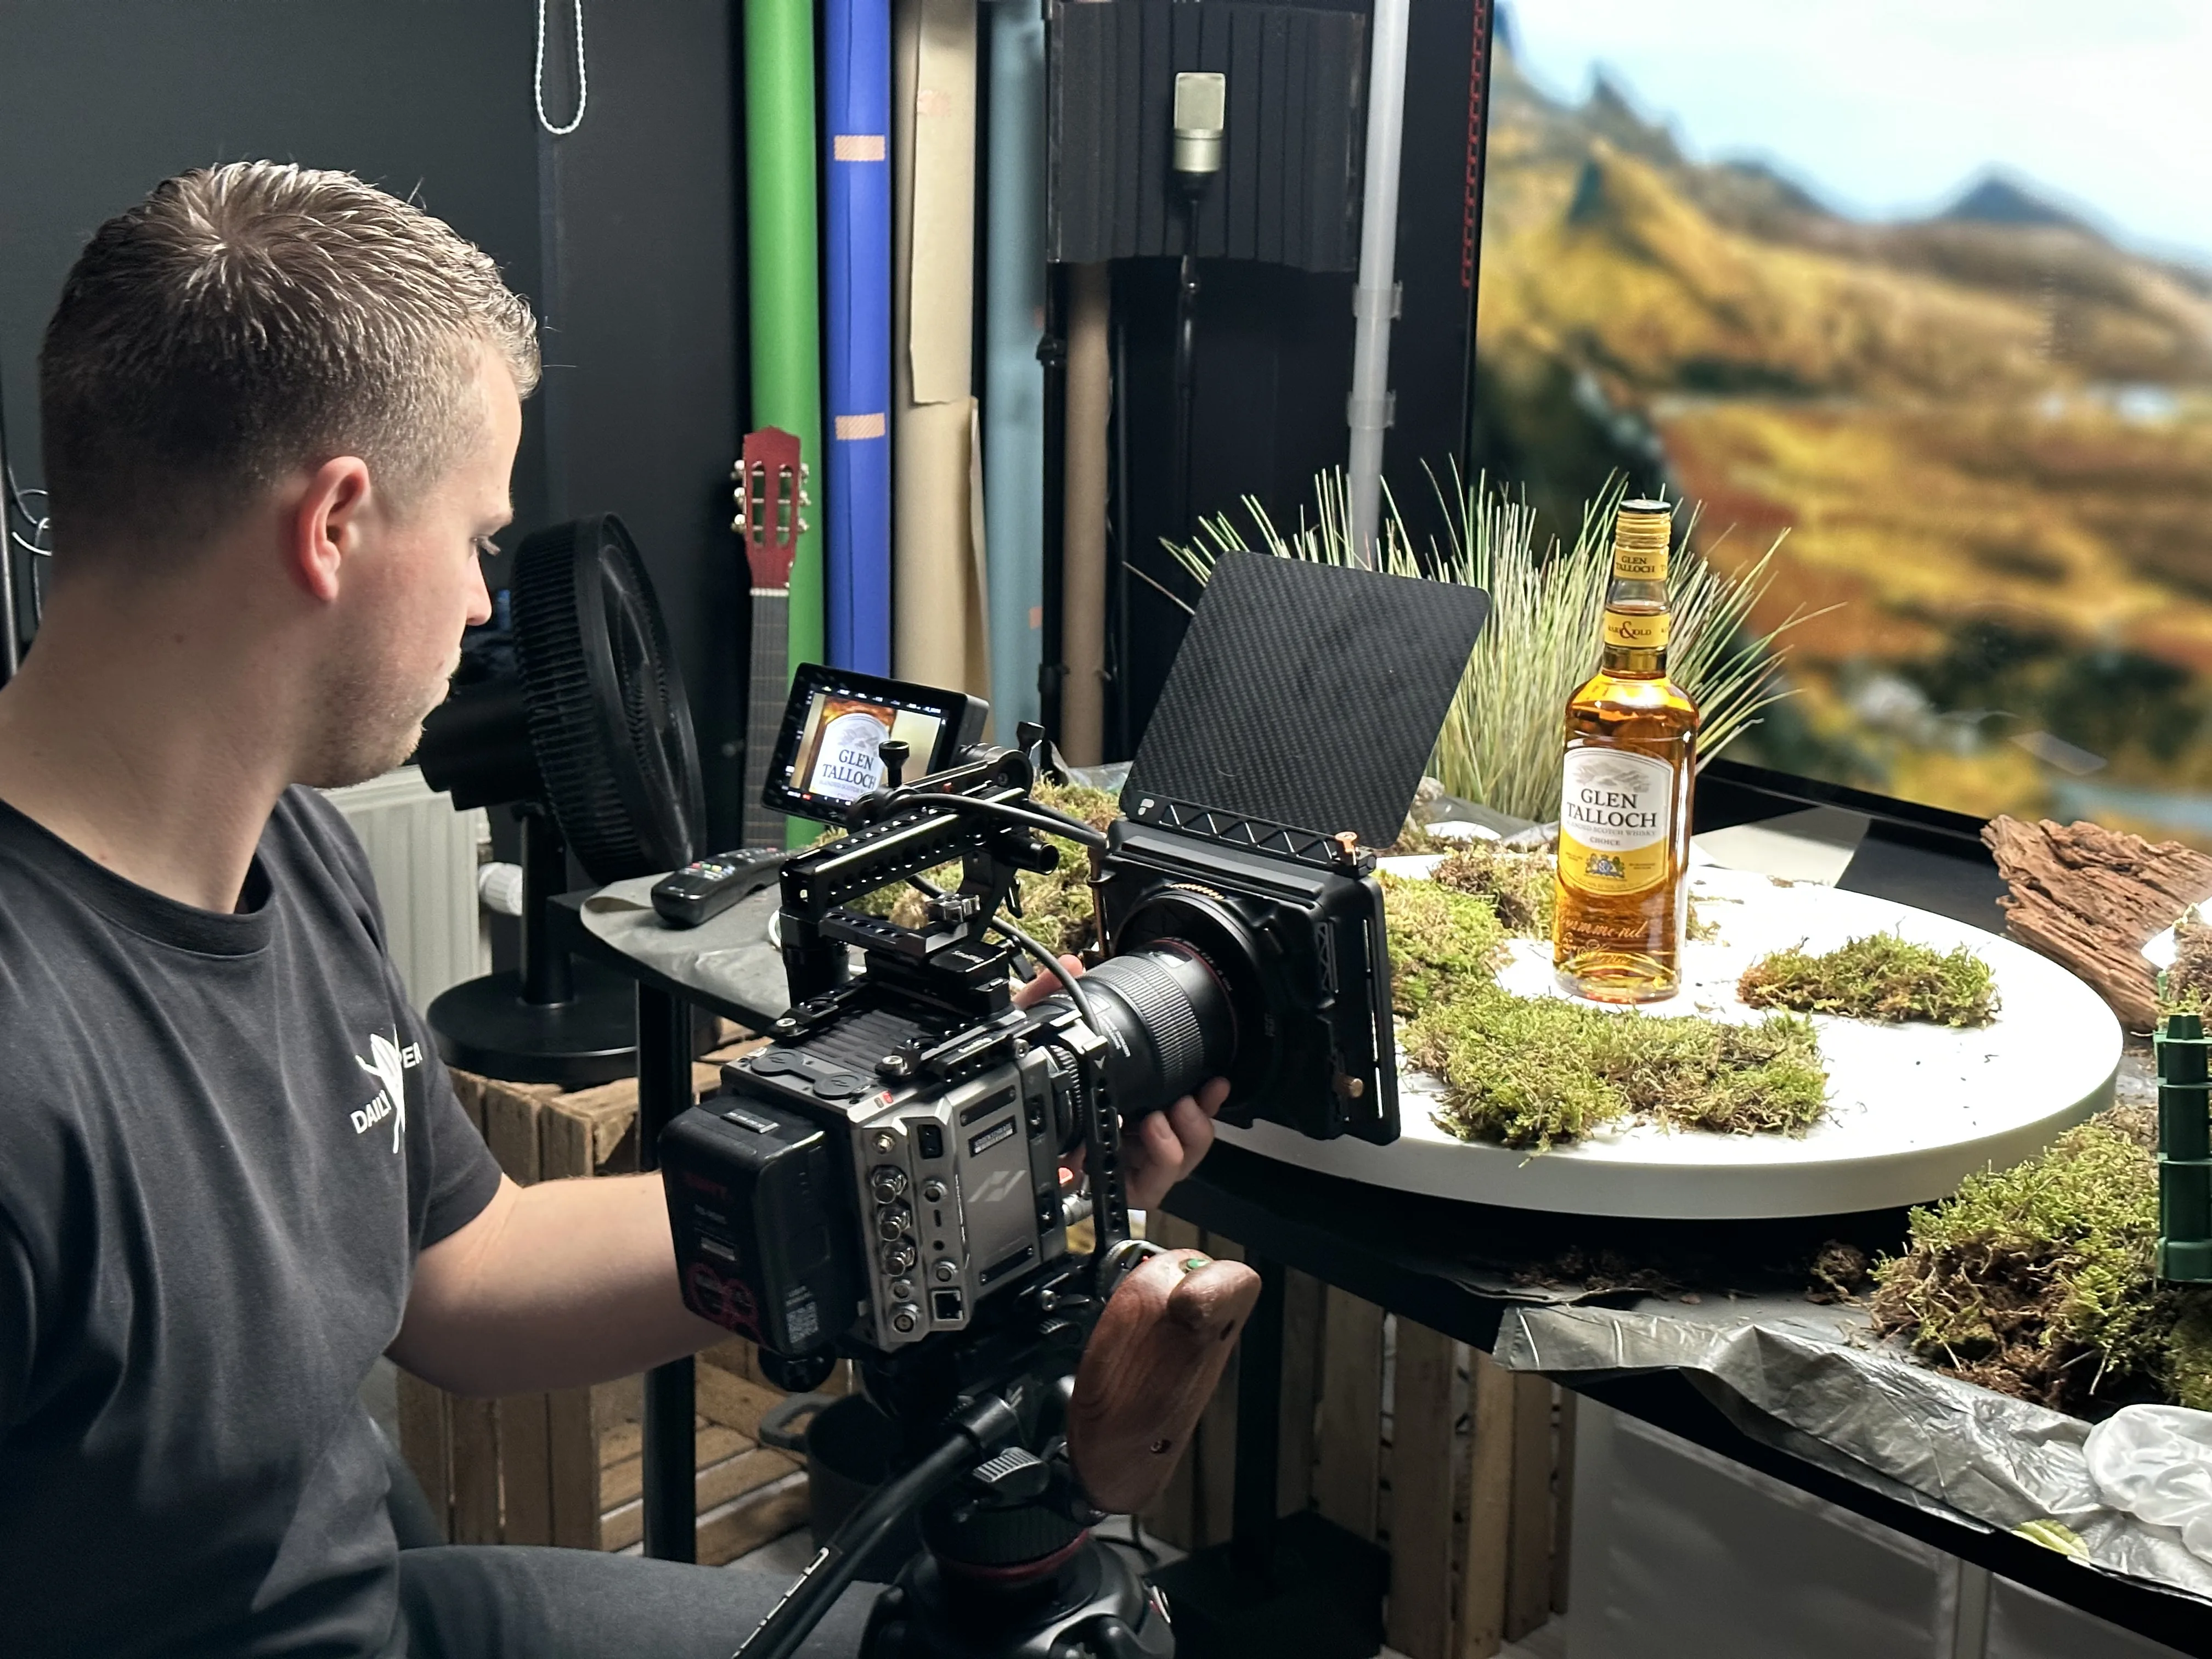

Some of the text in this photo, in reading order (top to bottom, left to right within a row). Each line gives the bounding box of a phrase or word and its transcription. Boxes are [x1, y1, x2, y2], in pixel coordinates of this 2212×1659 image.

[1622, 555, 1647, 565] GLEN
[1620, 621, 1638, 639] &
[839, 749, 874, 771] GLEN
[822, 764, 877, 790] TALLOCH
[1581, 788, 1638, 809] GLEN
[1567, 802, 1657, 828] TALLOCH
[1589, 836, 1621, 846] CHOICE
[1594, 826, 1623, 835] SCOTCH
[350, 1089, 391, 1134] DAILY
